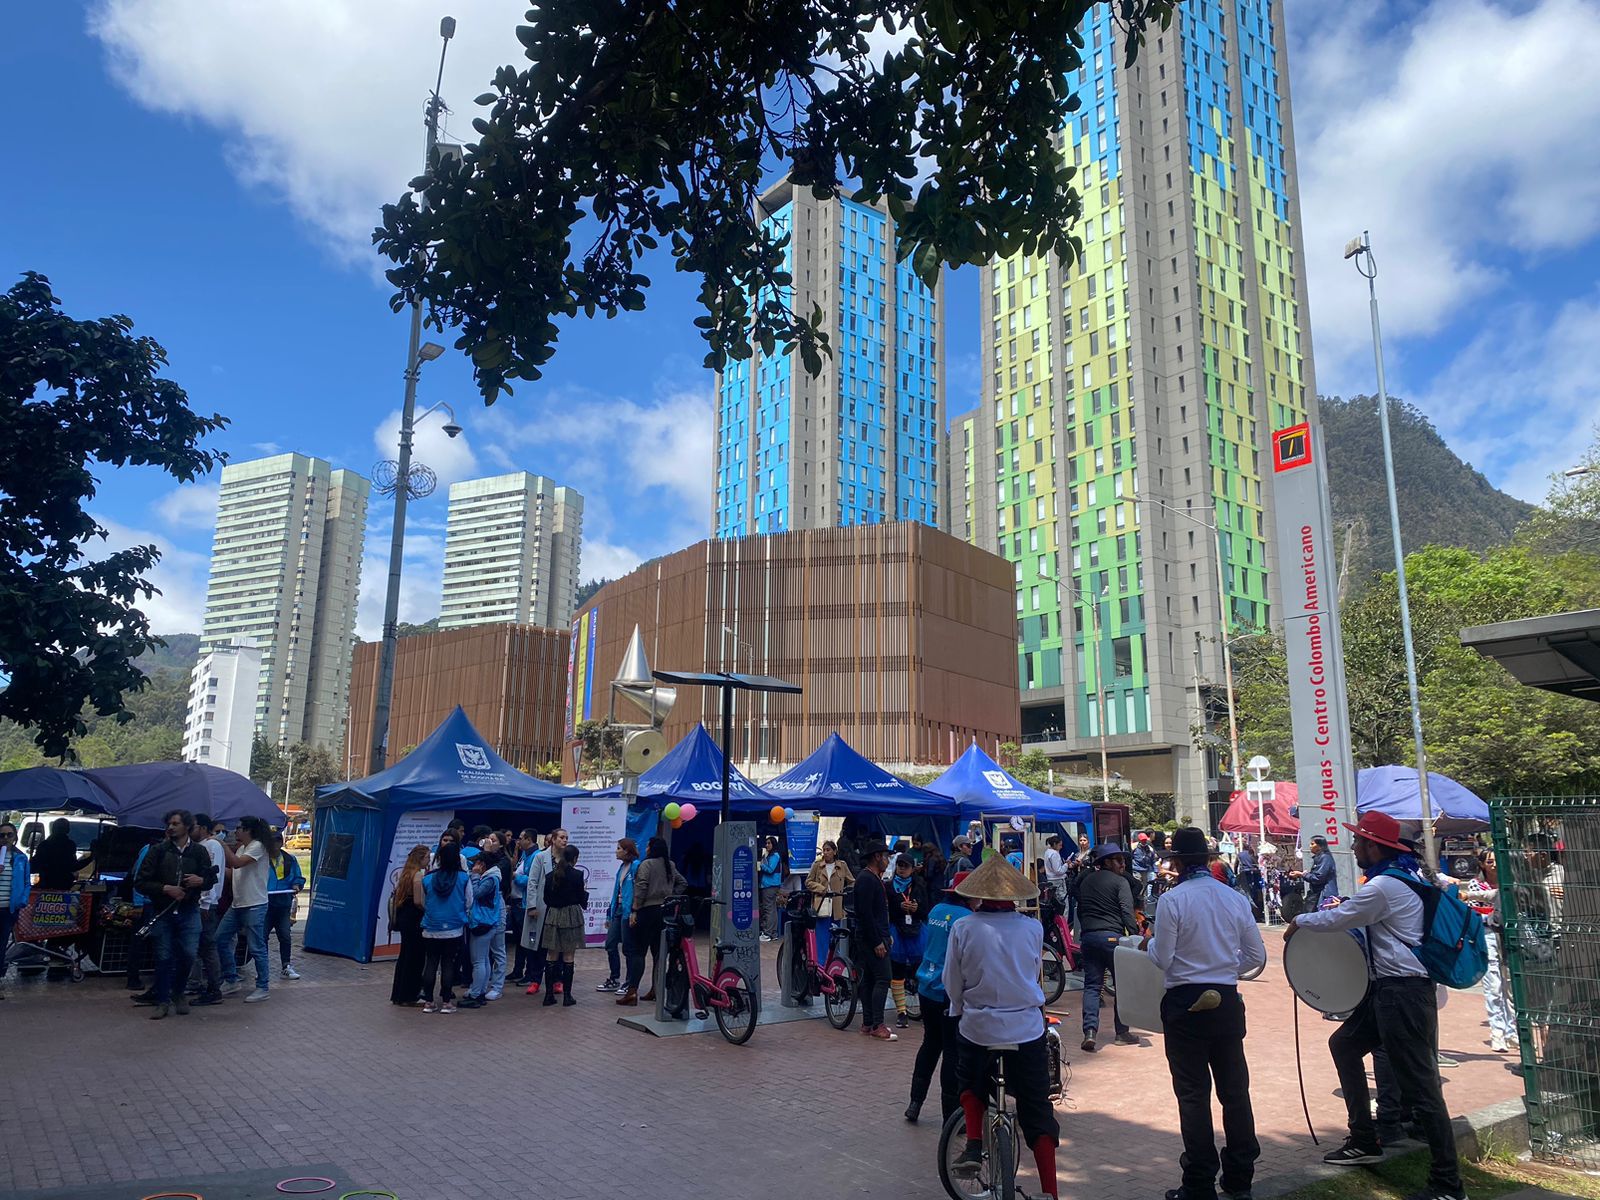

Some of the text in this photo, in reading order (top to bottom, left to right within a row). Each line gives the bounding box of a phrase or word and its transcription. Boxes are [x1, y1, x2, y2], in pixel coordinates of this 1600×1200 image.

[1301, 525, 1319, 611] Americano
[1305, 614, 1325, 687] Colombo
[1314, 688, 1330, 747] Centro
[1320, 759, 1338, 814] Aguas
[1325, 817, 1340, 847] Las
[35, 903, 67, 914] JUGOS
